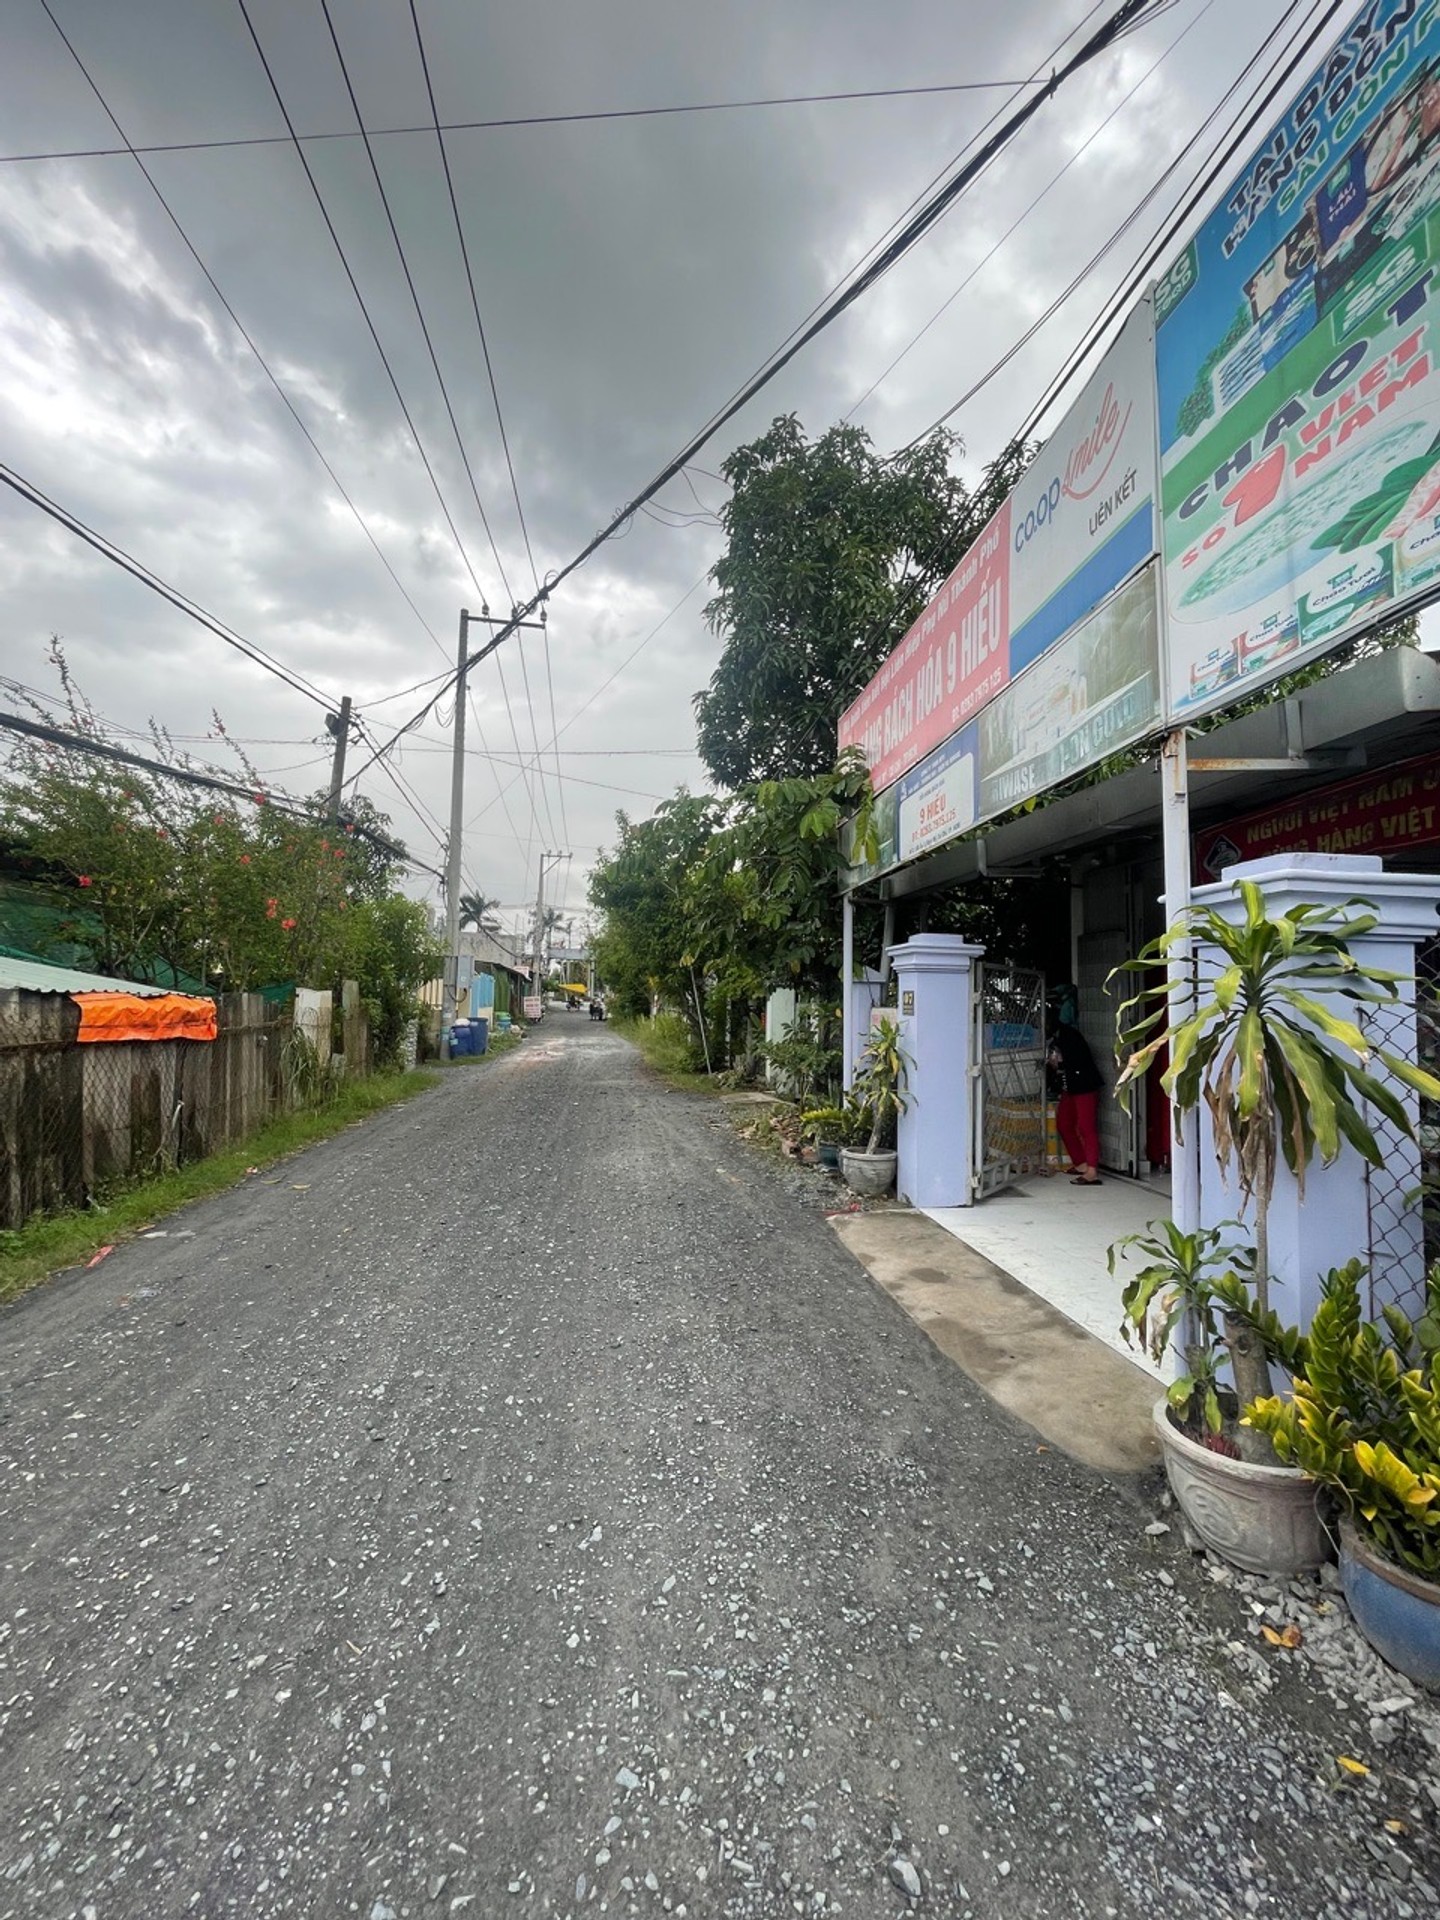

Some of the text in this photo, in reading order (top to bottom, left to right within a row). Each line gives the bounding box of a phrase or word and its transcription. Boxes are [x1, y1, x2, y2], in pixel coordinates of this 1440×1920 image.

[1278, 138, 1329, 216] SÀI
[1332, 34, 1409, 143] GÒN
[1222, 119, 1321, 259] HÀNG
[1155, 252, 1191, 308] SG
[1345, 244, 1416, 320] SG
[1294, 353, 1430, 479] NAM
[1114, 467, 1138, 510] KẾT
[860, 720, 882, 769] ÀNG
[884, 685, 913, 757] BÁCH
[916, 643, 943, 725] HÓA
[947, 631, 957, 694] 9
[961, 567, 1001, 681] HIẾU
[1317, 823, 1374, 852] HÀNG
[1380, 805, 1436, 838] VIỆT
